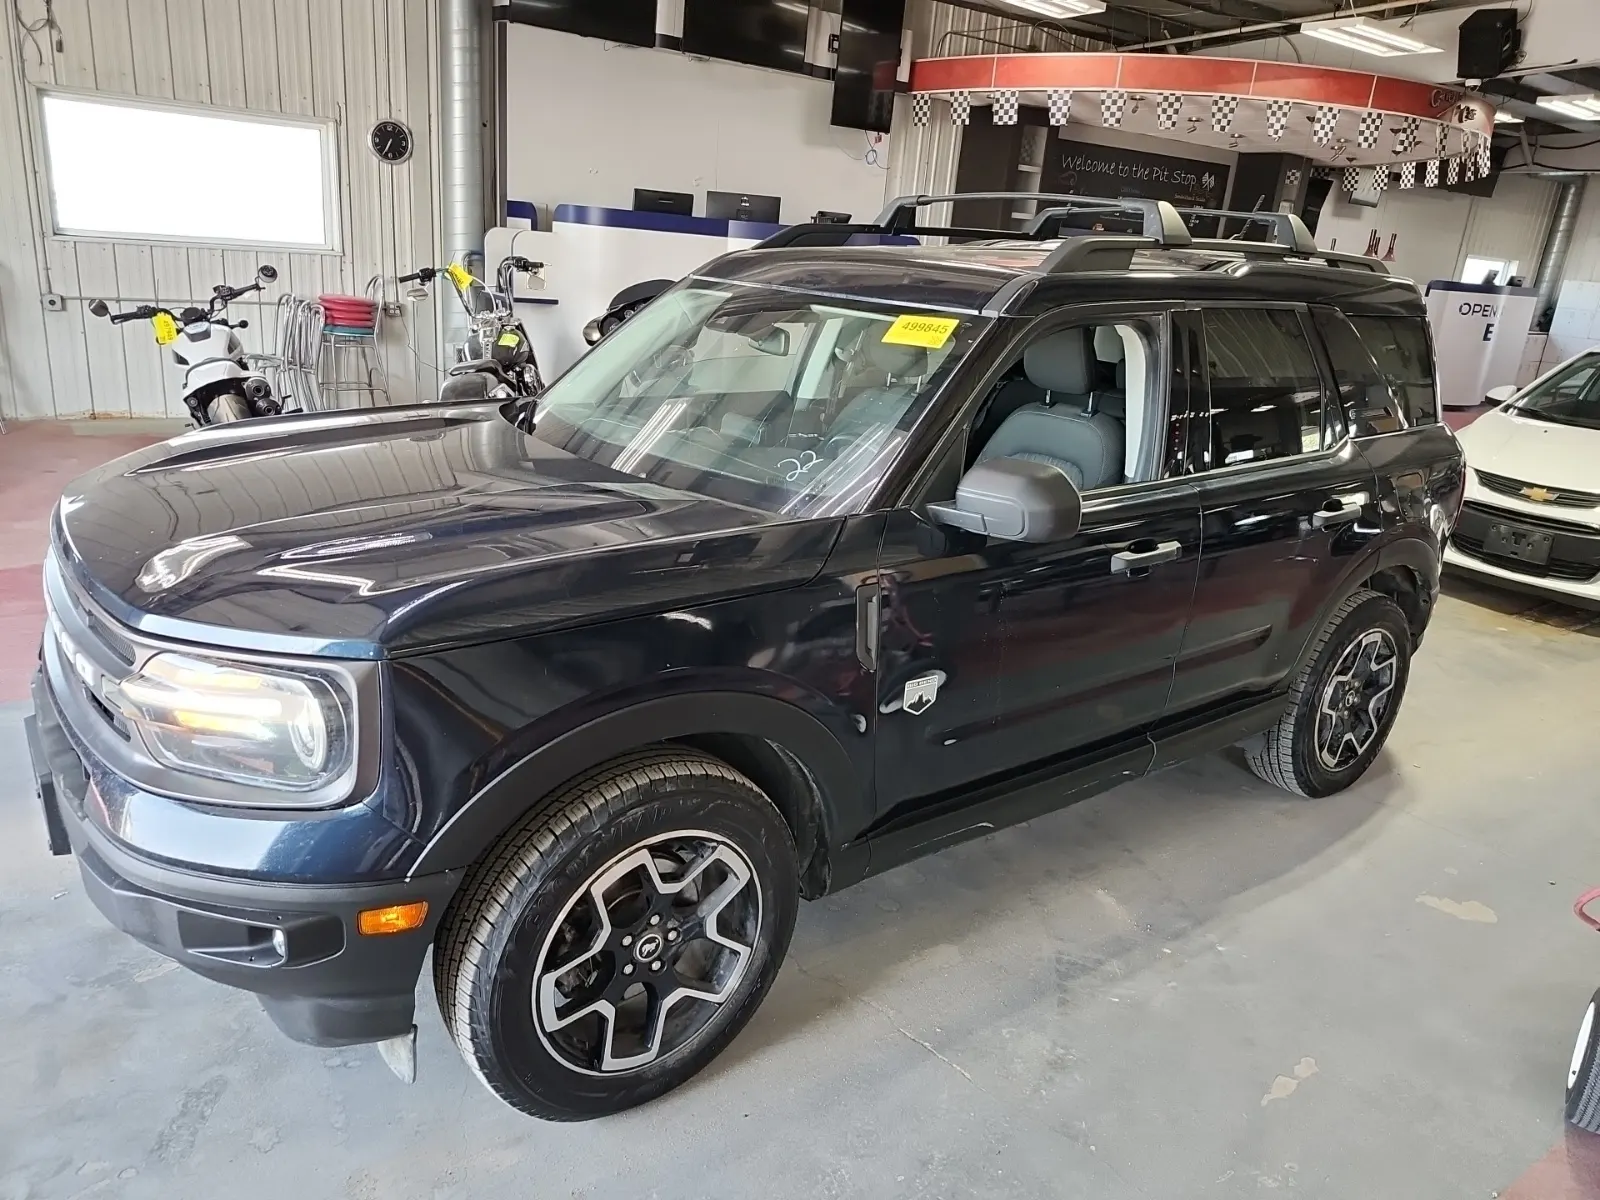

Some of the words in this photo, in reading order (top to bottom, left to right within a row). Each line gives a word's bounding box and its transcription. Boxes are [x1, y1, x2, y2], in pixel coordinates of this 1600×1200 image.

[1062, 153, 1115, 175] Welcome
[1118, 161, 1129, 178] to
[1132, 163, 1149, 181] the
[1152, 166, 1169, 183] Pit
[1171, 170, 1197, 191] Stop
[902, 321, 949, 334] 499845
[777, 450, 824, 482] 22
